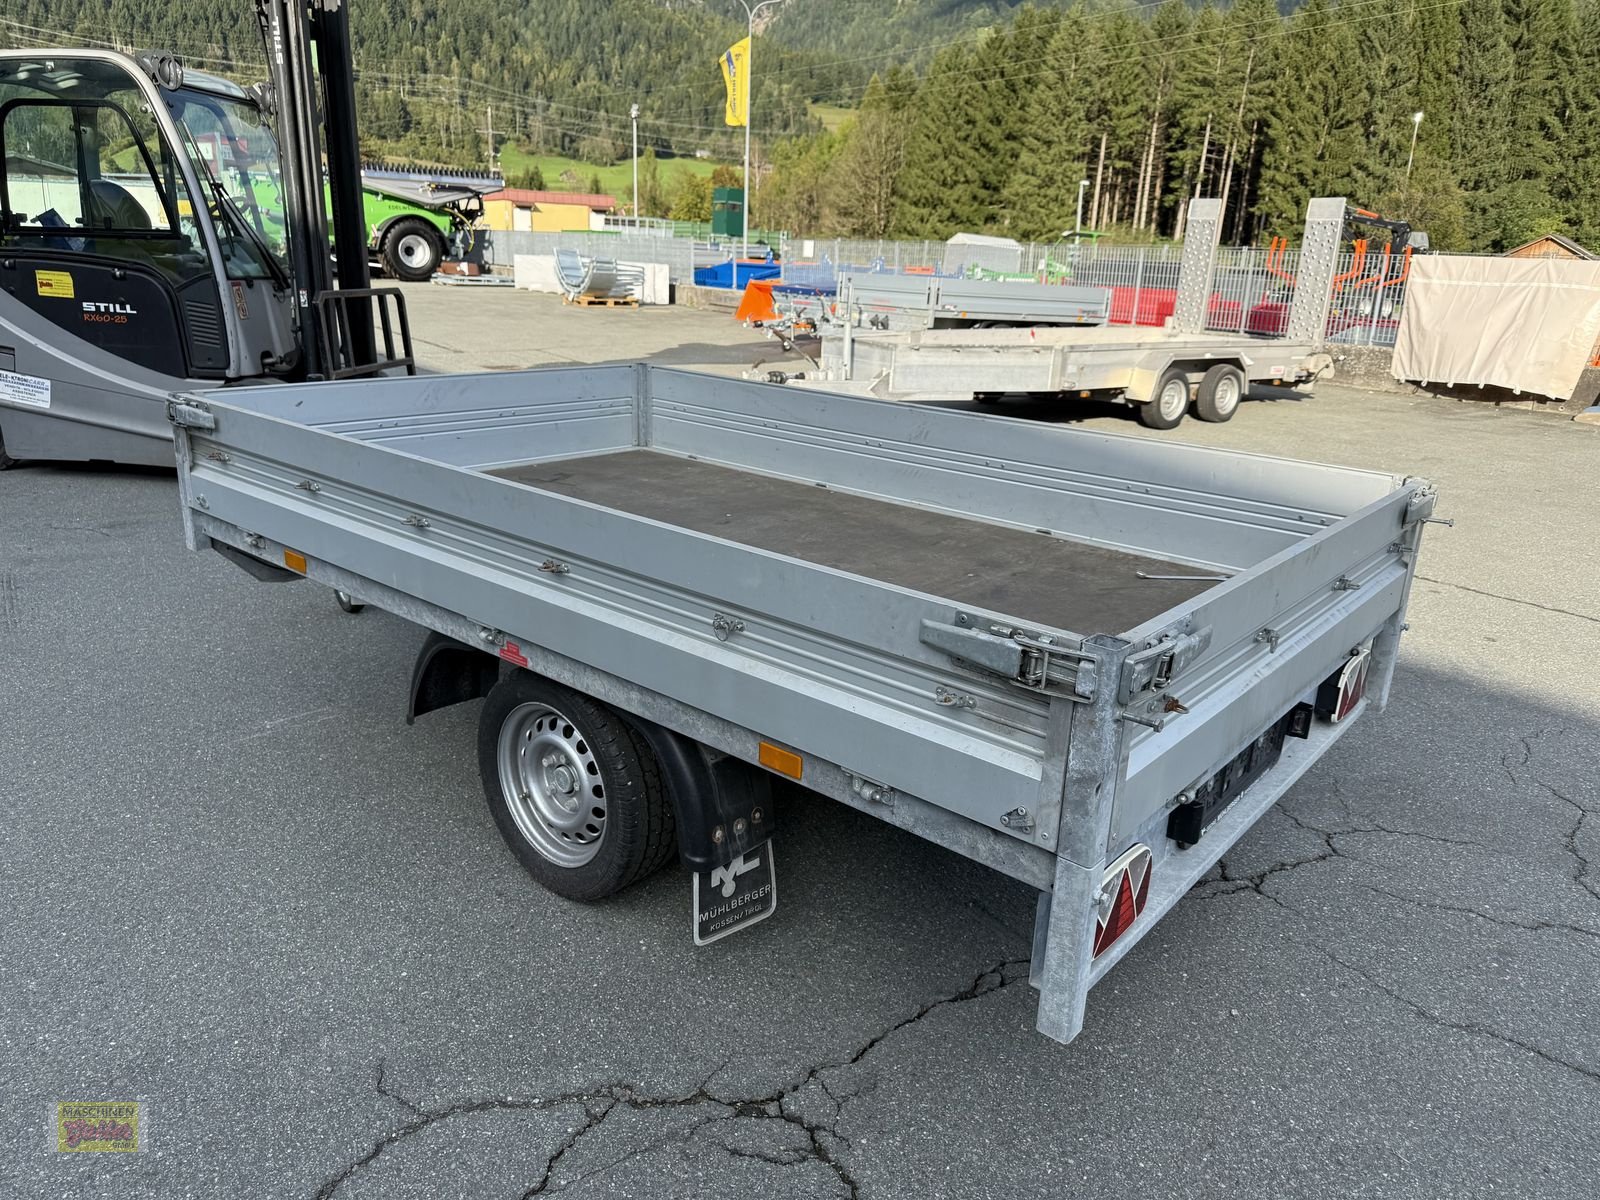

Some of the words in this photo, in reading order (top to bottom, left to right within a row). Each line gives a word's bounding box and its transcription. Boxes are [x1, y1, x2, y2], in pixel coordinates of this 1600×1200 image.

[271, 15, 284, 65] STILL
[82, 302, 137, 314] STILL
[83, 313, 128, 324] RX60-25
[699, 884, 771, 923] MÜHLBERGER
